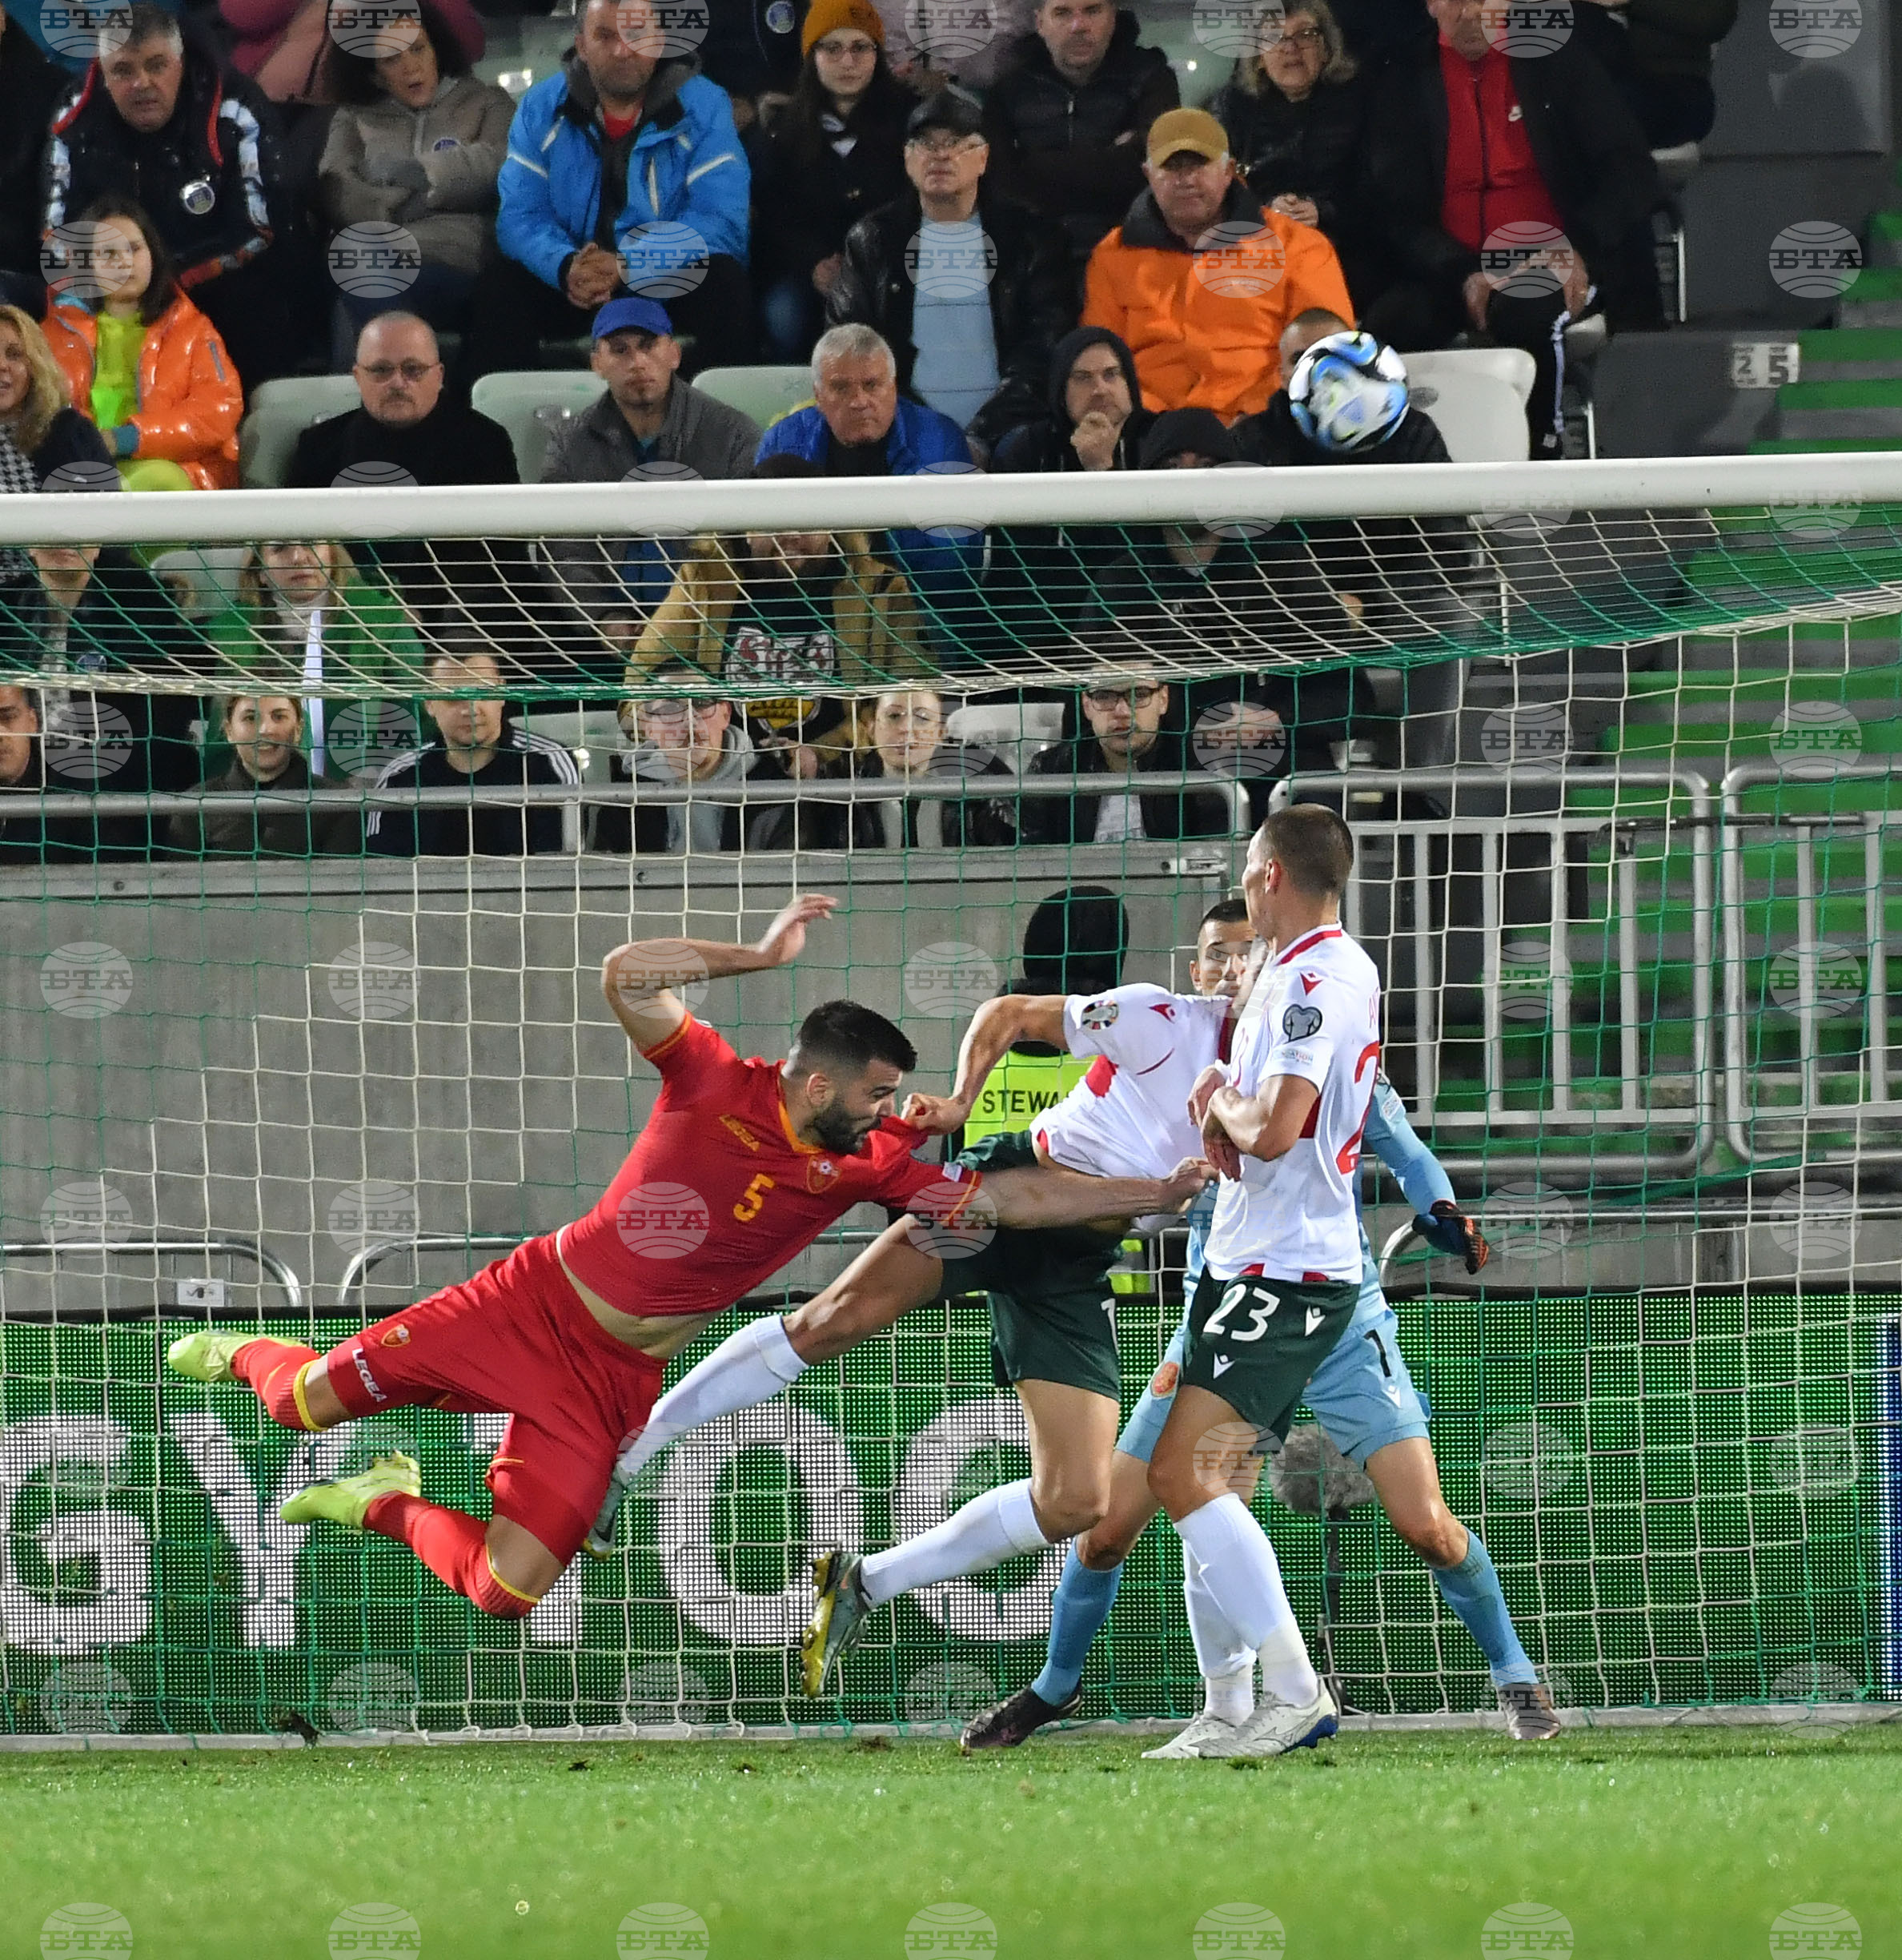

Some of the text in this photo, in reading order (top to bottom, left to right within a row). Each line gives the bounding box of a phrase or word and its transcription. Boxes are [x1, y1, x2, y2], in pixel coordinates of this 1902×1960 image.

[982, 1089, 1069, 1114] STEWA
[733, 1173, 775, 1221] 5
[1202, 1283, 1281, 1341] 23
[352, 1348, 387, 1402] LEGEA
[1363, 1329, 1392, 1377] 1
